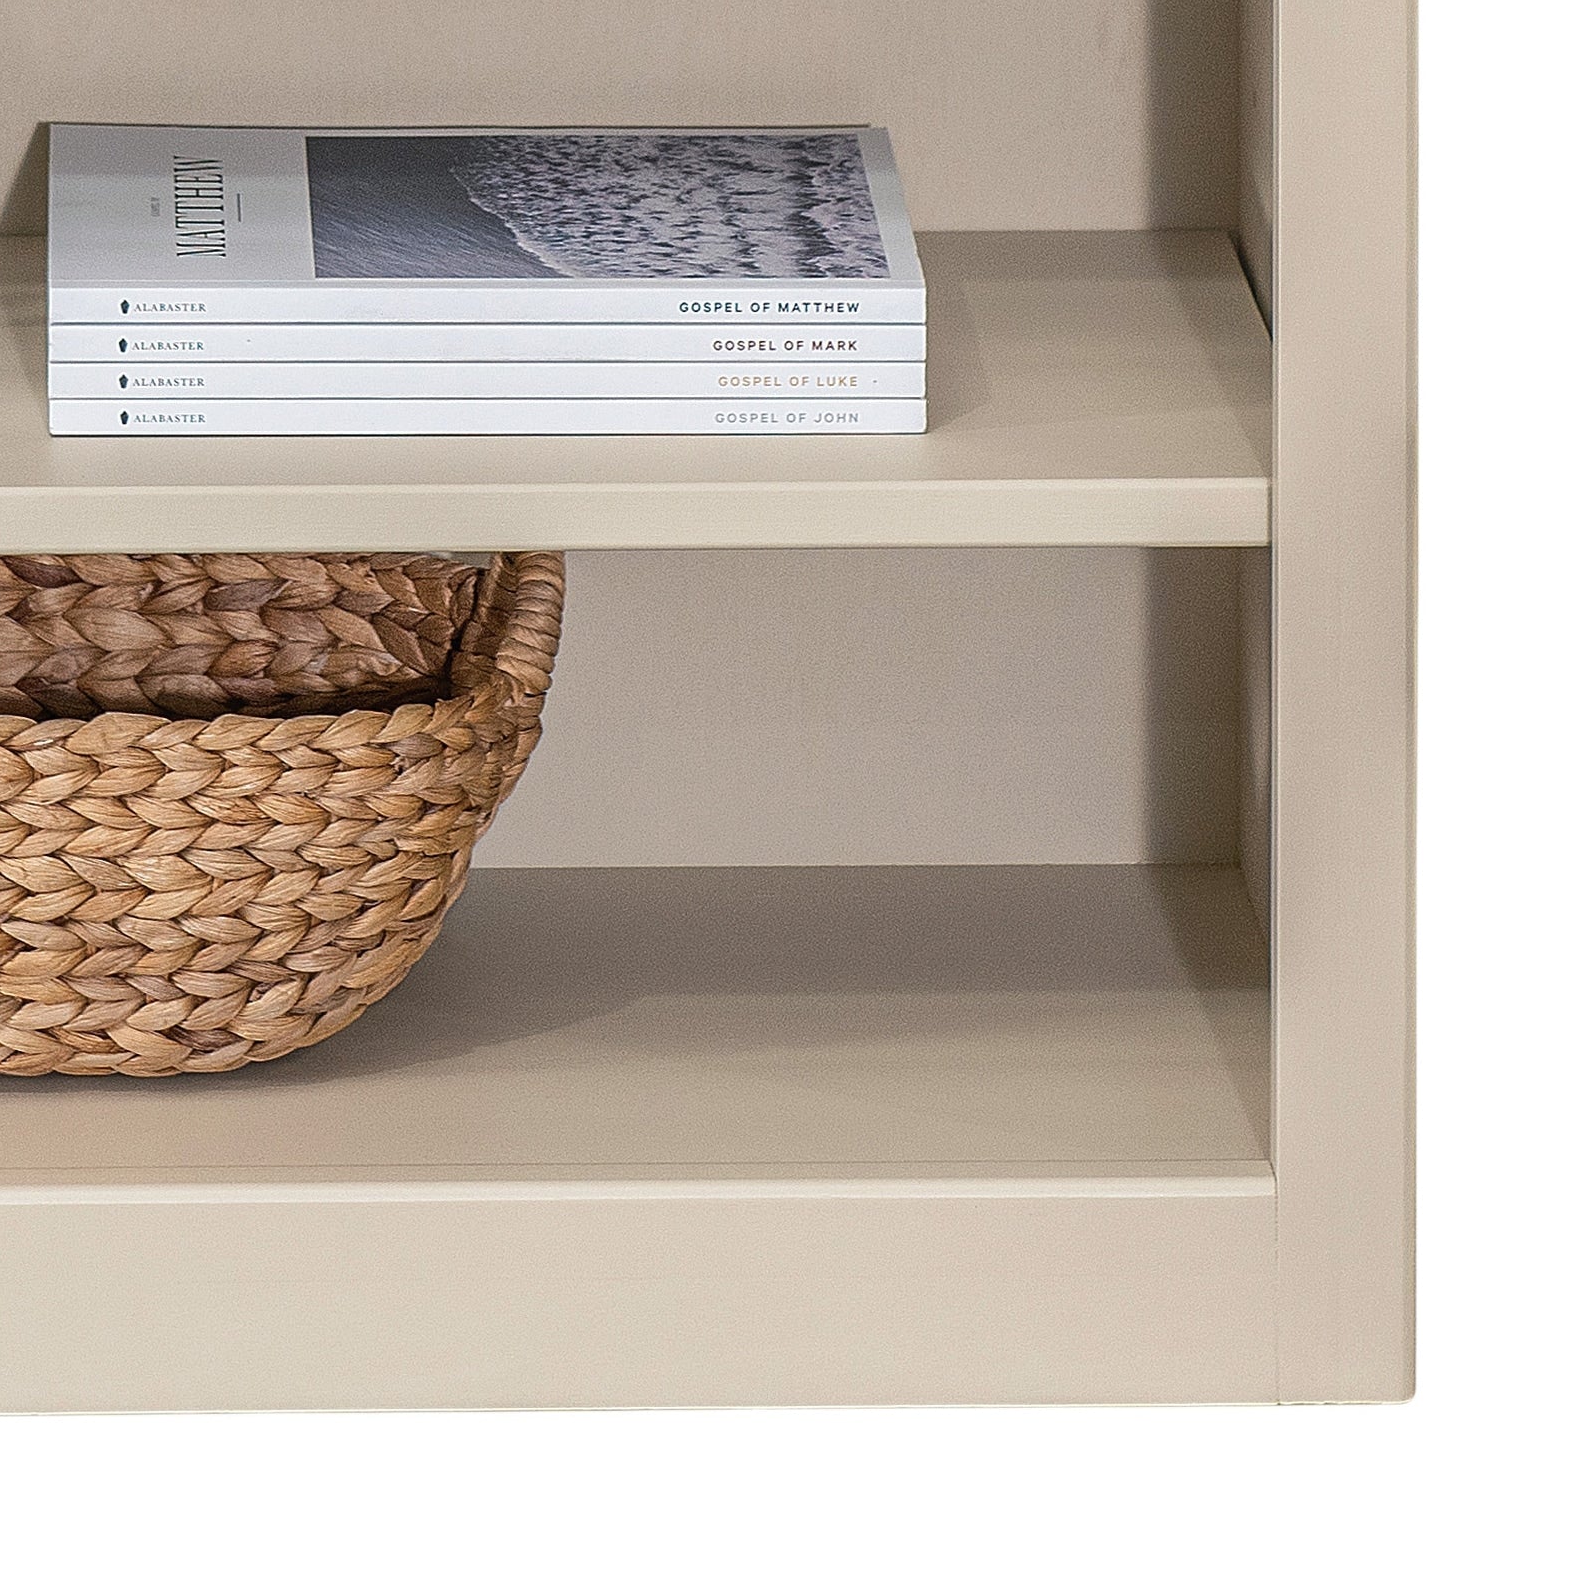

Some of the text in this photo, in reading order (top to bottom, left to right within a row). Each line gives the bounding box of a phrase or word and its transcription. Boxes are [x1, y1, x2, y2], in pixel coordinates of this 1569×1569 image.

[173, 155, 226, 257] MATTHEW
[133, 303, 207, 312] ALABASTER
[679, 301, 860, 313] GOSPEL OF MATTHEW
[131, 341, 205, 351] ALABASTER
[712, 340, 858, 351] GOSPEL OF MARK
[132, 377, 205, 387] ALABASTER
[718, 376, 858, 387] GOSPEL OF LUKE
[133, 414, 206, 423] ALABASTER
[715, 413, 859, 423] GOSPEL OF JOHN
